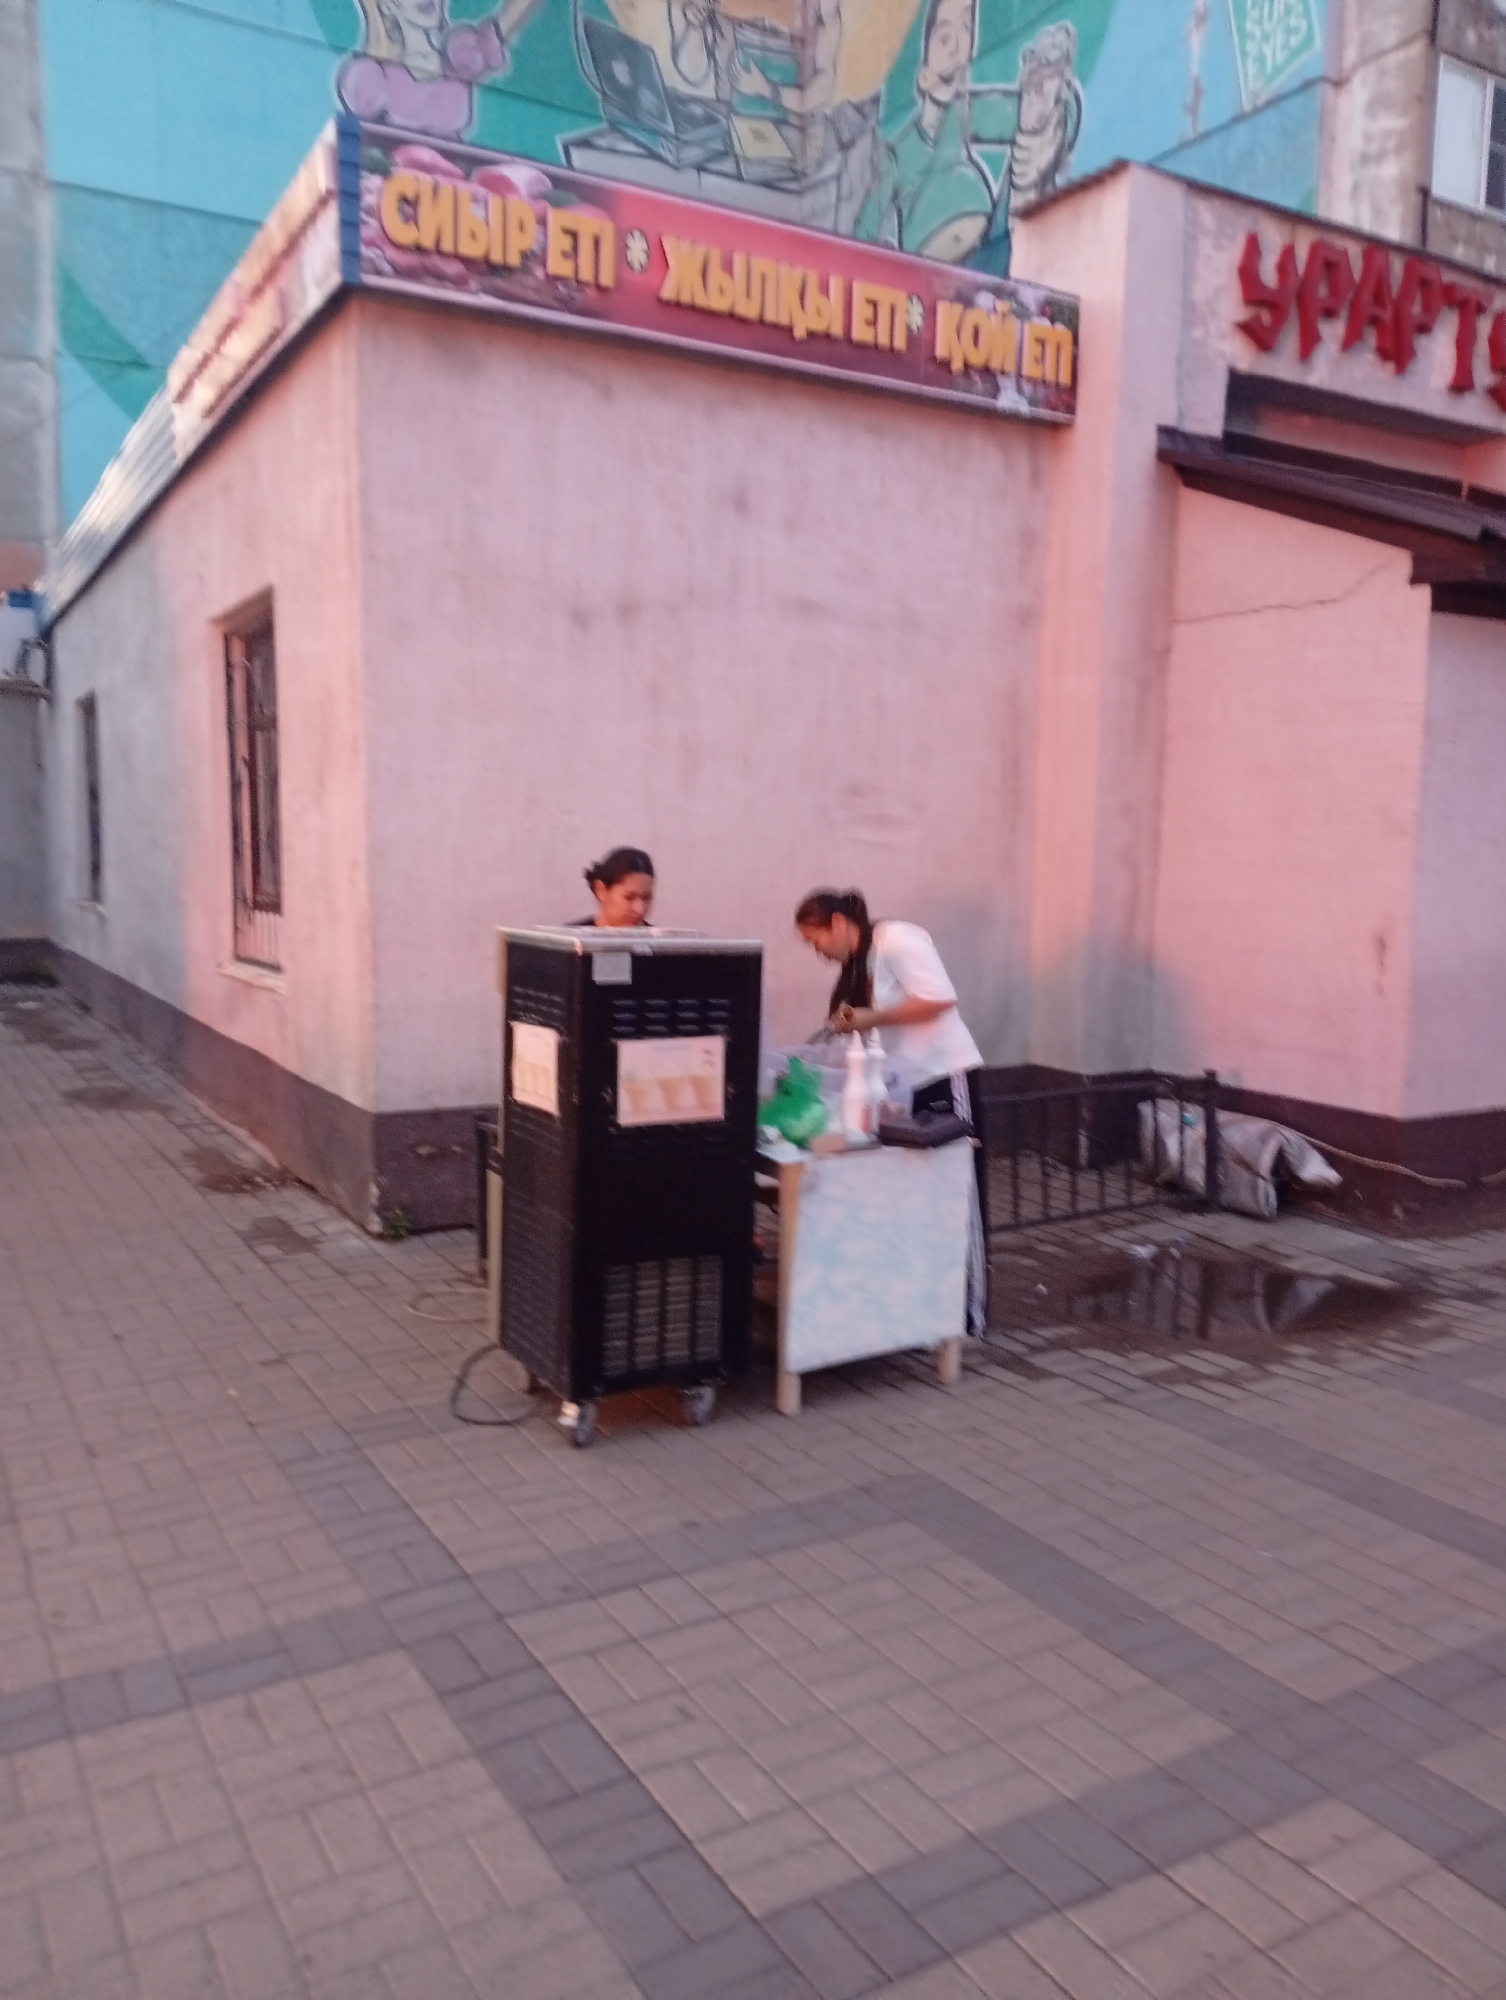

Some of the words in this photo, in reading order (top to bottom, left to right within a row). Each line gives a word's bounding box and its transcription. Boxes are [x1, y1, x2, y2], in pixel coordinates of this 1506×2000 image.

[380, 171, 537, 268] СИЫР
[659, 237, 844, 341] ЖЫЛҚЫ
[934, 300, 1017, 375] ҚОЙ
